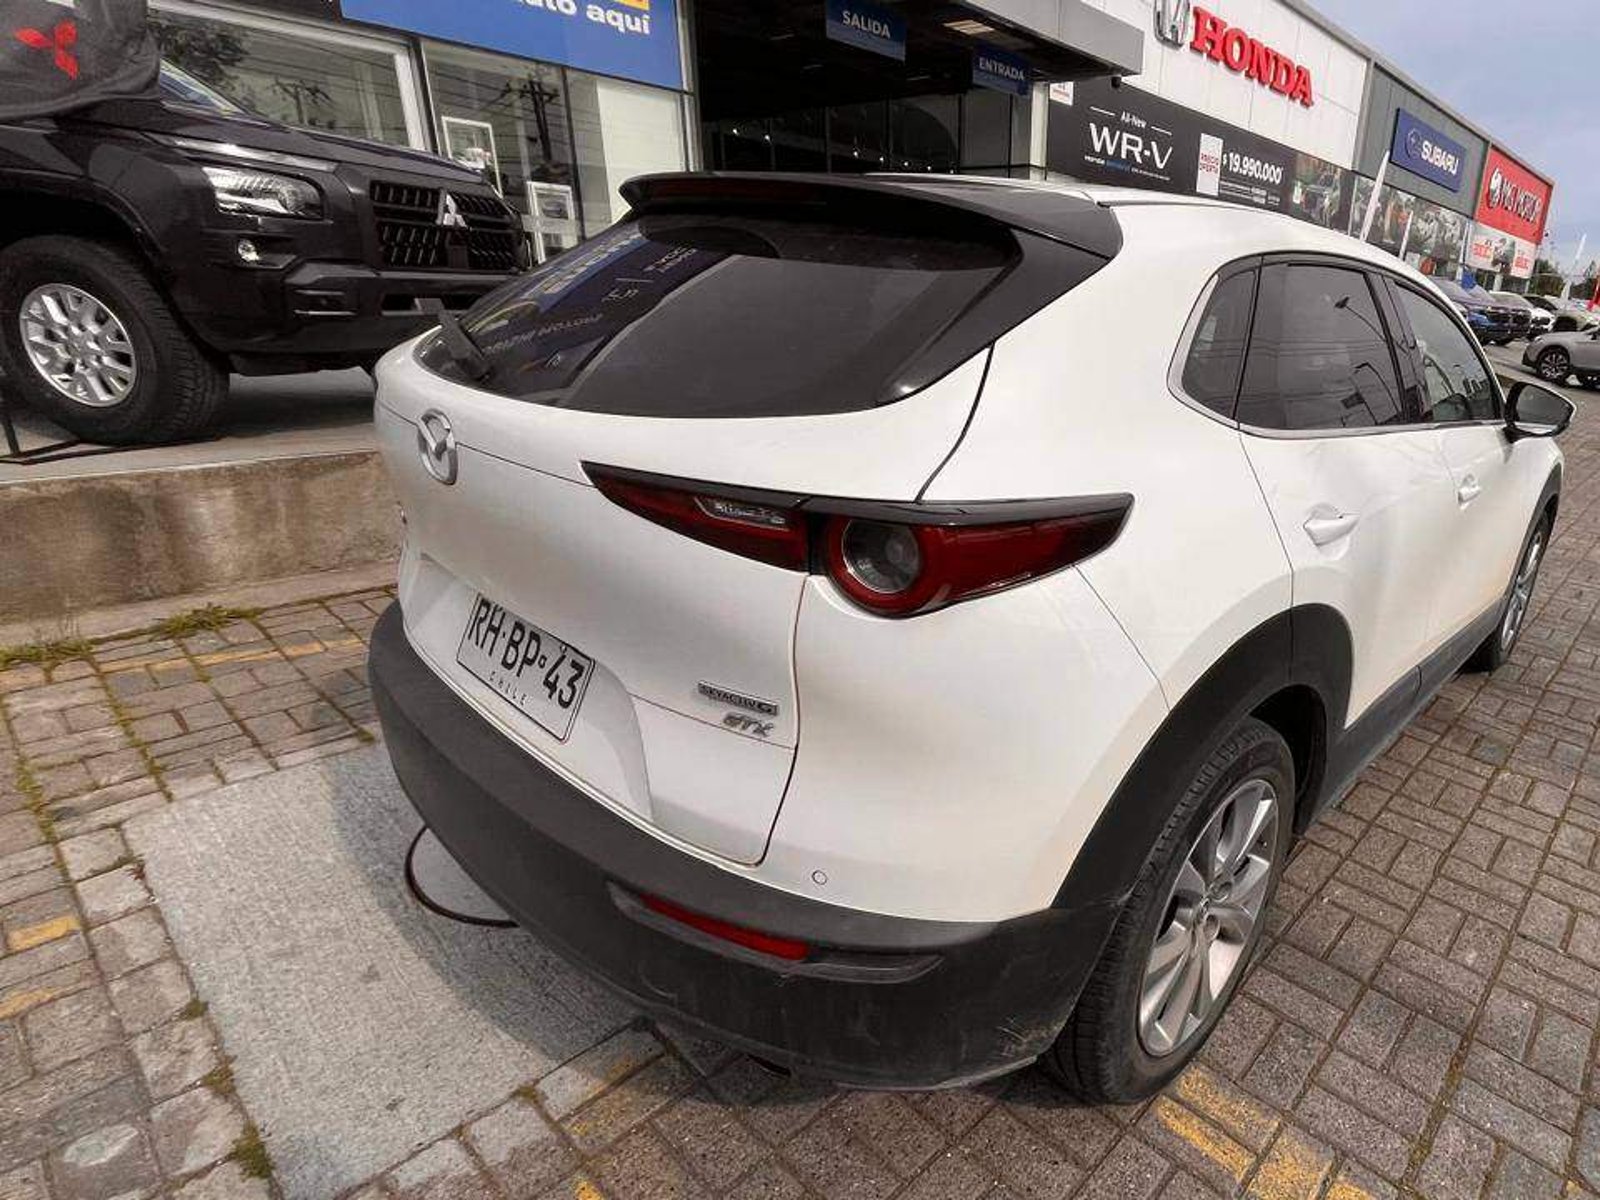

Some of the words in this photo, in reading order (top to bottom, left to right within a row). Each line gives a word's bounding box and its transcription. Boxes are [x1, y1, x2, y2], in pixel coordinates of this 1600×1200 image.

[842, 10, 891, 39] SALIDA
[979, 57, 1025, 80] ENTRADA
[1190, 6, 1314, 108] HONDA
[1089, 122, 1173, 169] WR-V
[1421, 140, 1459, 176] SUBARU
[489, 671, 529, 706] CHILE
